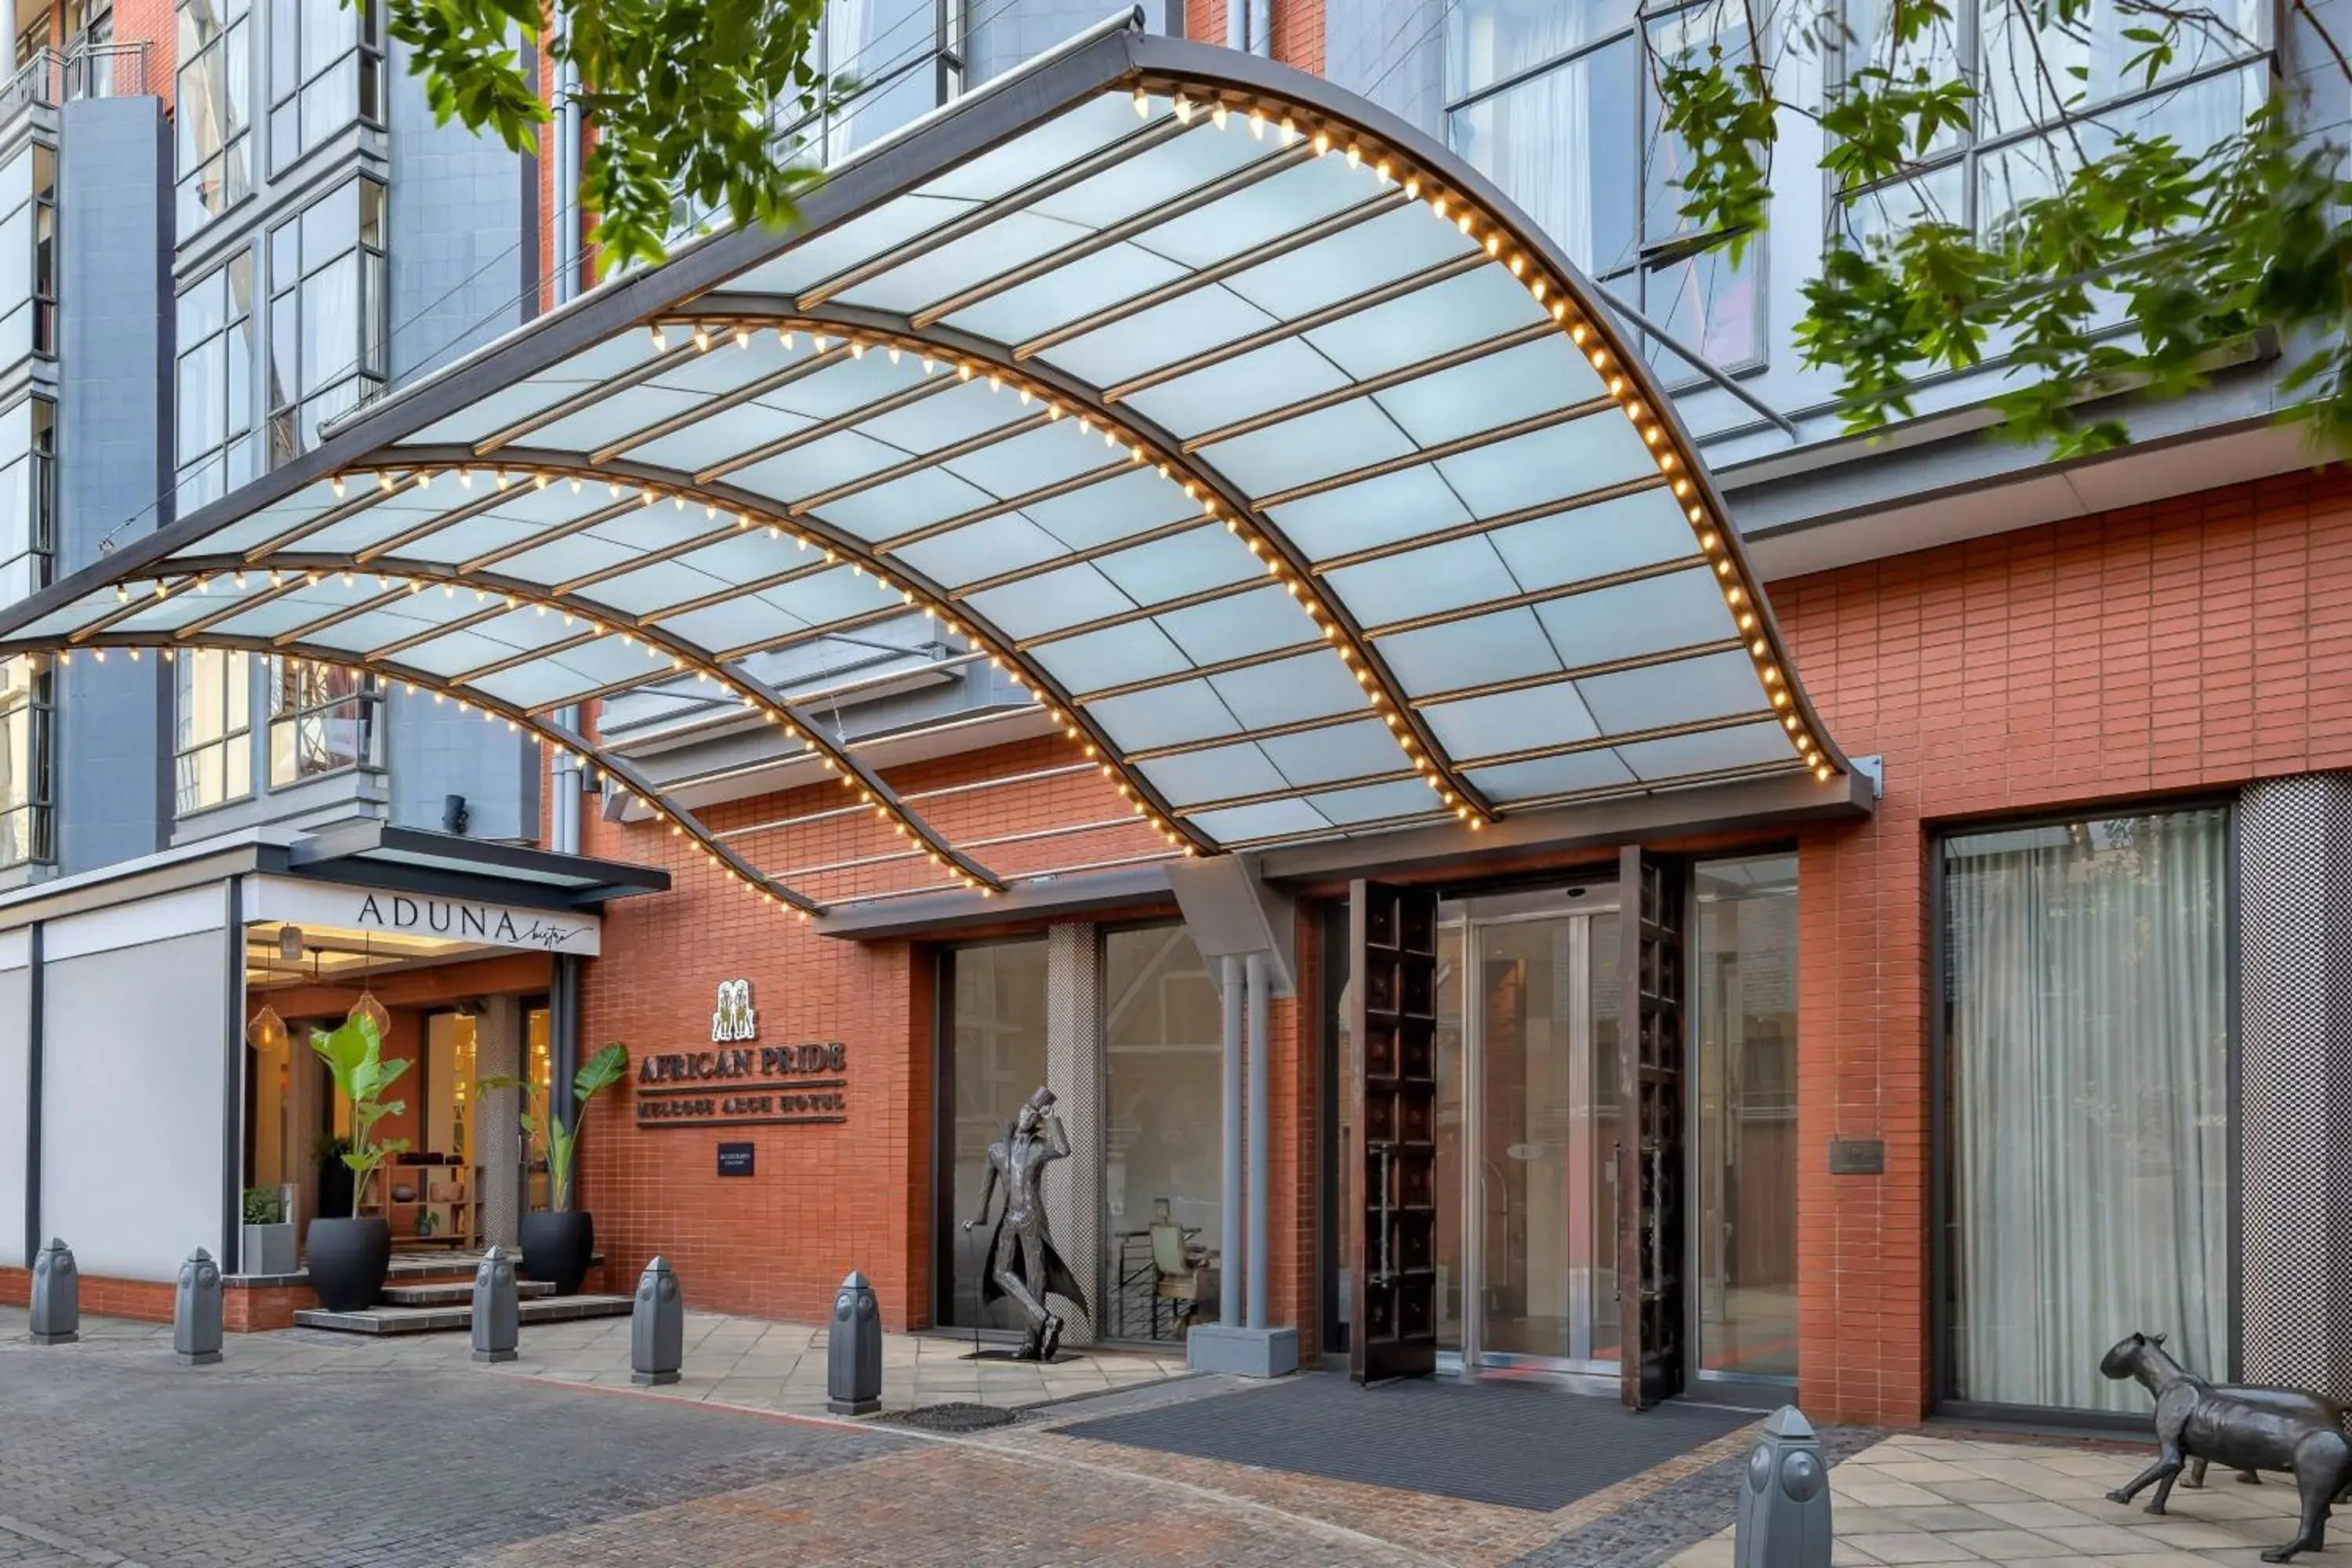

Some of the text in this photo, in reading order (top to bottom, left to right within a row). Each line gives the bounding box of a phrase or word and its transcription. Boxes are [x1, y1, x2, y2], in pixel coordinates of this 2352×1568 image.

[358, 892, 519, 942] ADUNA
[639, 1042, 847, 1082] AFRICAN PRIDE
